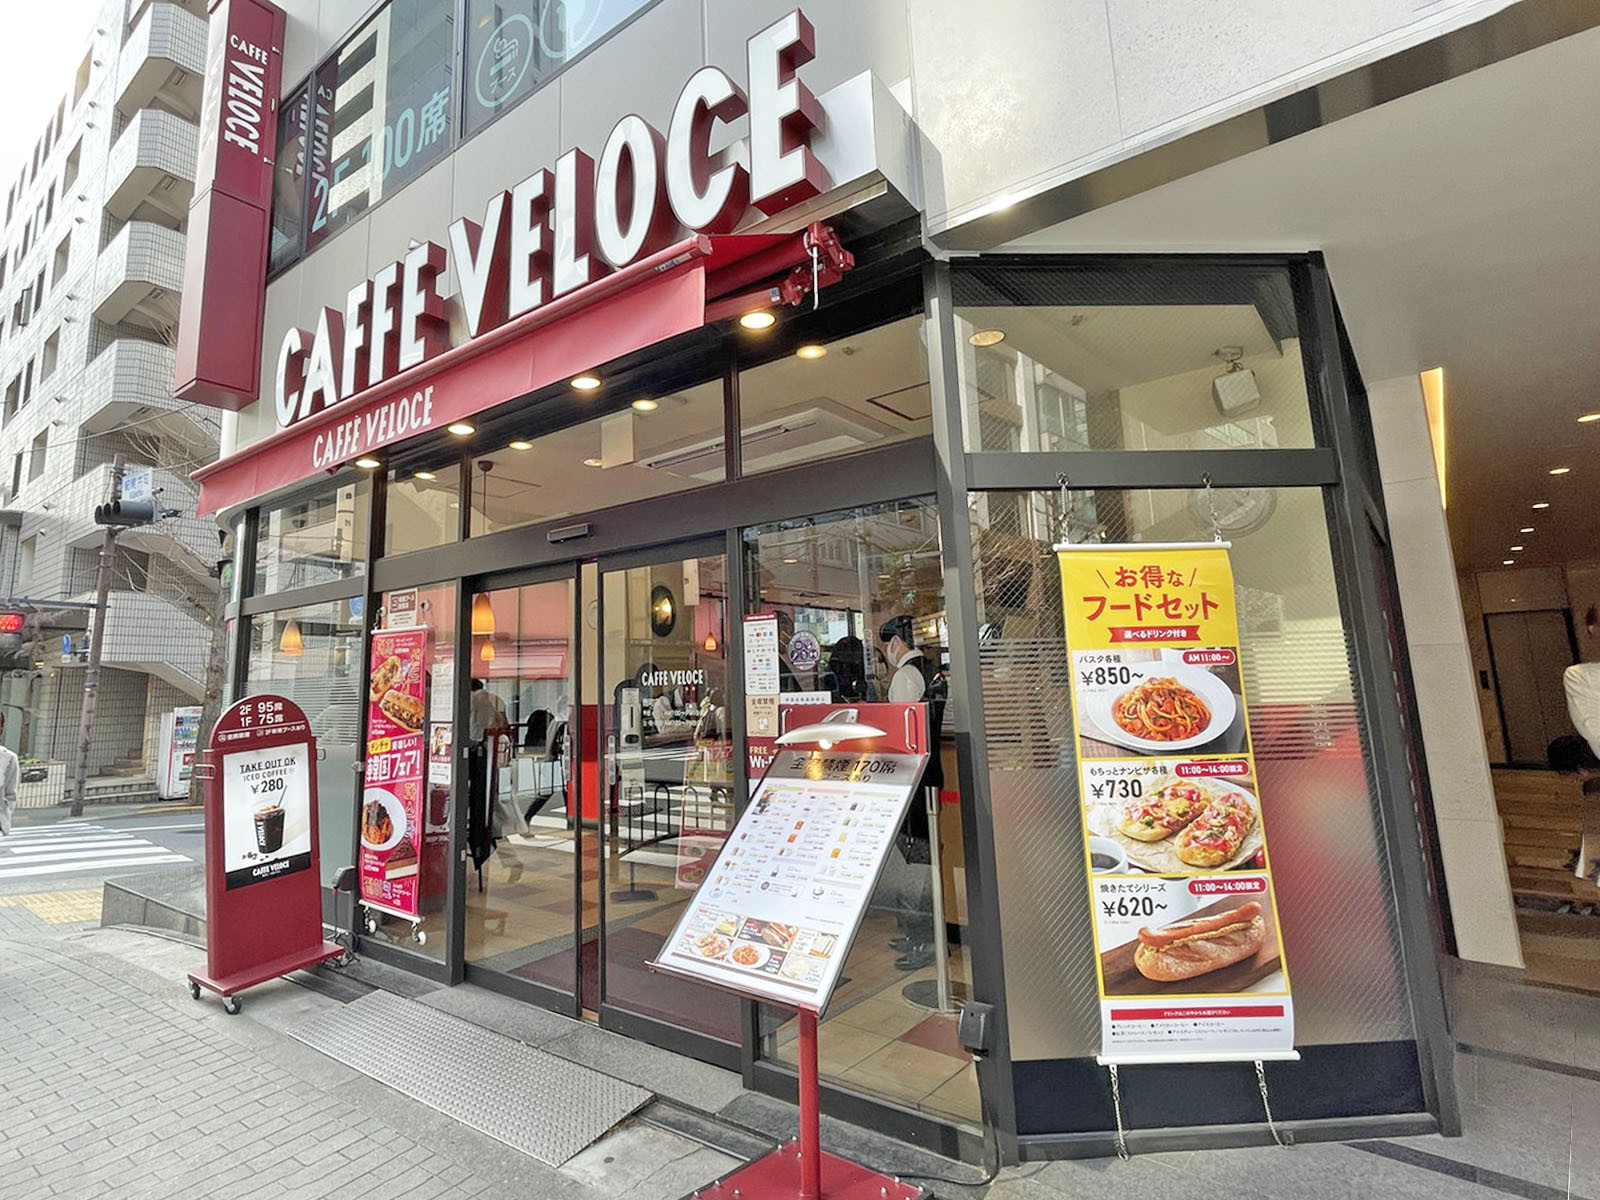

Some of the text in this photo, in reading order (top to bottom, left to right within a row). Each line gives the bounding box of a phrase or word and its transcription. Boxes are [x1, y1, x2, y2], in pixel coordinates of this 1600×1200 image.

[224, 60, 264, 154] VELOCE
[449, 11, 804, 338] VELOCE
[366, 385, 434, 446] VELOCE
[1115, 565, 1184, 589] お得な
[1082, 592, 1219, 621] フードセット
[1080, 654, 1121, 663] パスタ各種
[669, 669, 704, 685] VELOCE
[239, 704, 252, 716] 2F
[240, 717, 252, 727] 1F
[749, 746, 768, 755] FREE
[240, 757, 296, 774] TAKE OUT OK
[243, 769, 287, 781] ICED COFFEE
[1091, 779, 1143, 798] ¥730
[1100, 883, 1166, 893] 焼きたてシリーズ
